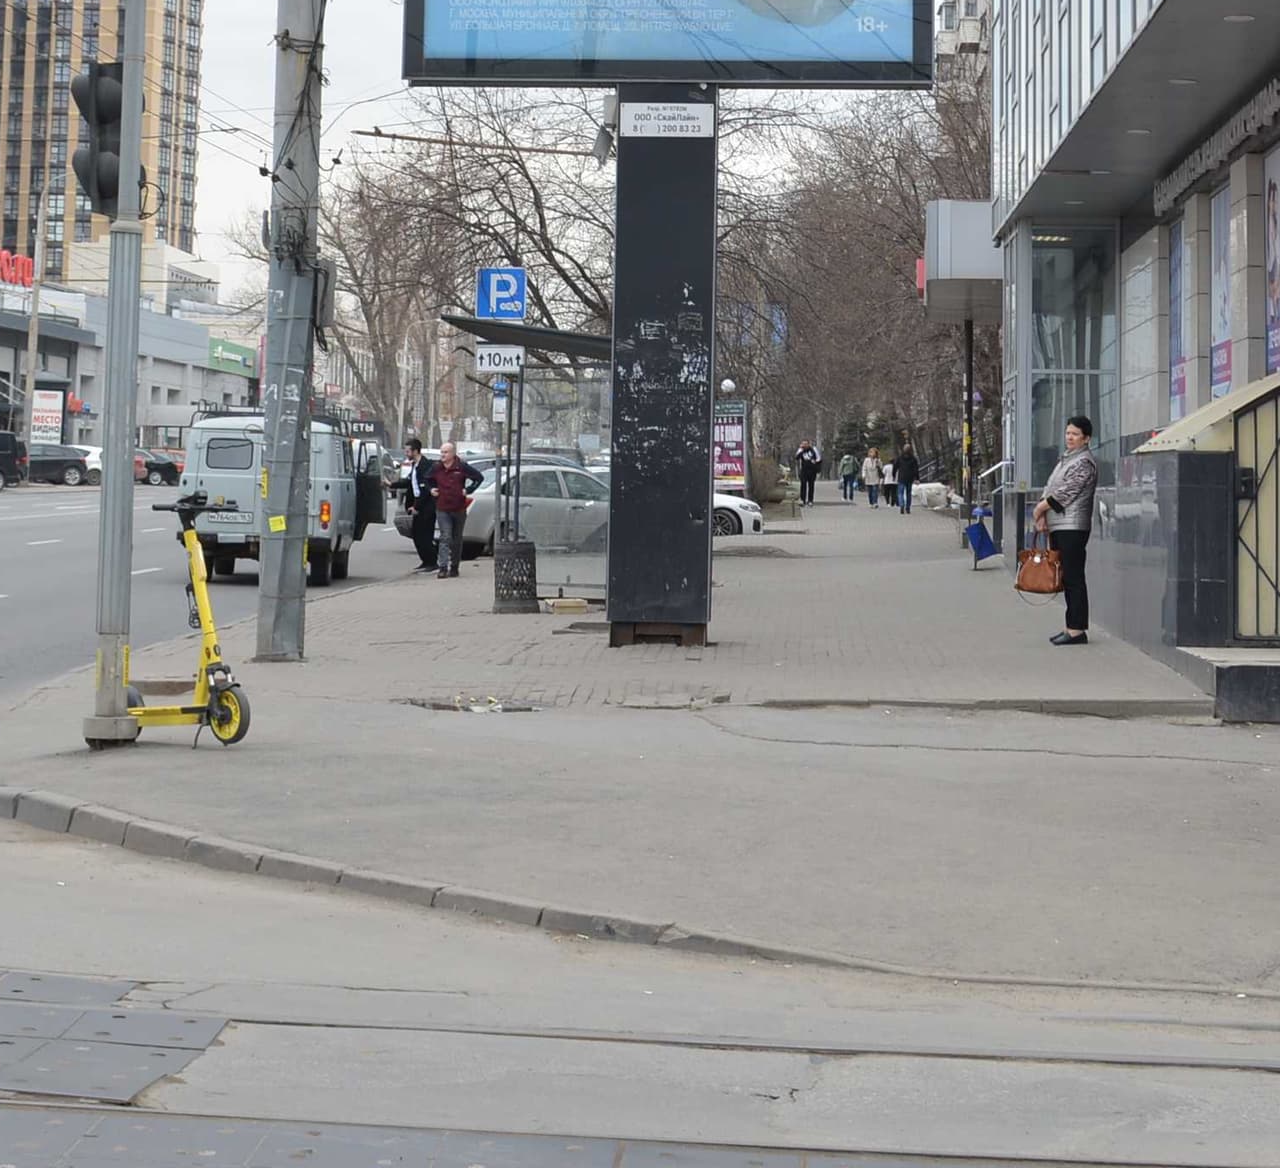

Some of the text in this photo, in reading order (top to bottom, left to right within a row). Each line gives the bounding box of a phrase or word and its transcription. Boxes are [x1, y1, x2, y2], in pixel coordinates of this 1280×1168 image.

[855, 16, 889, 33] 18+
[661, 125, 678, 133] 200
[690, 125, 701, 133] 23
[33, 415, 61, 425] МЕСТО
